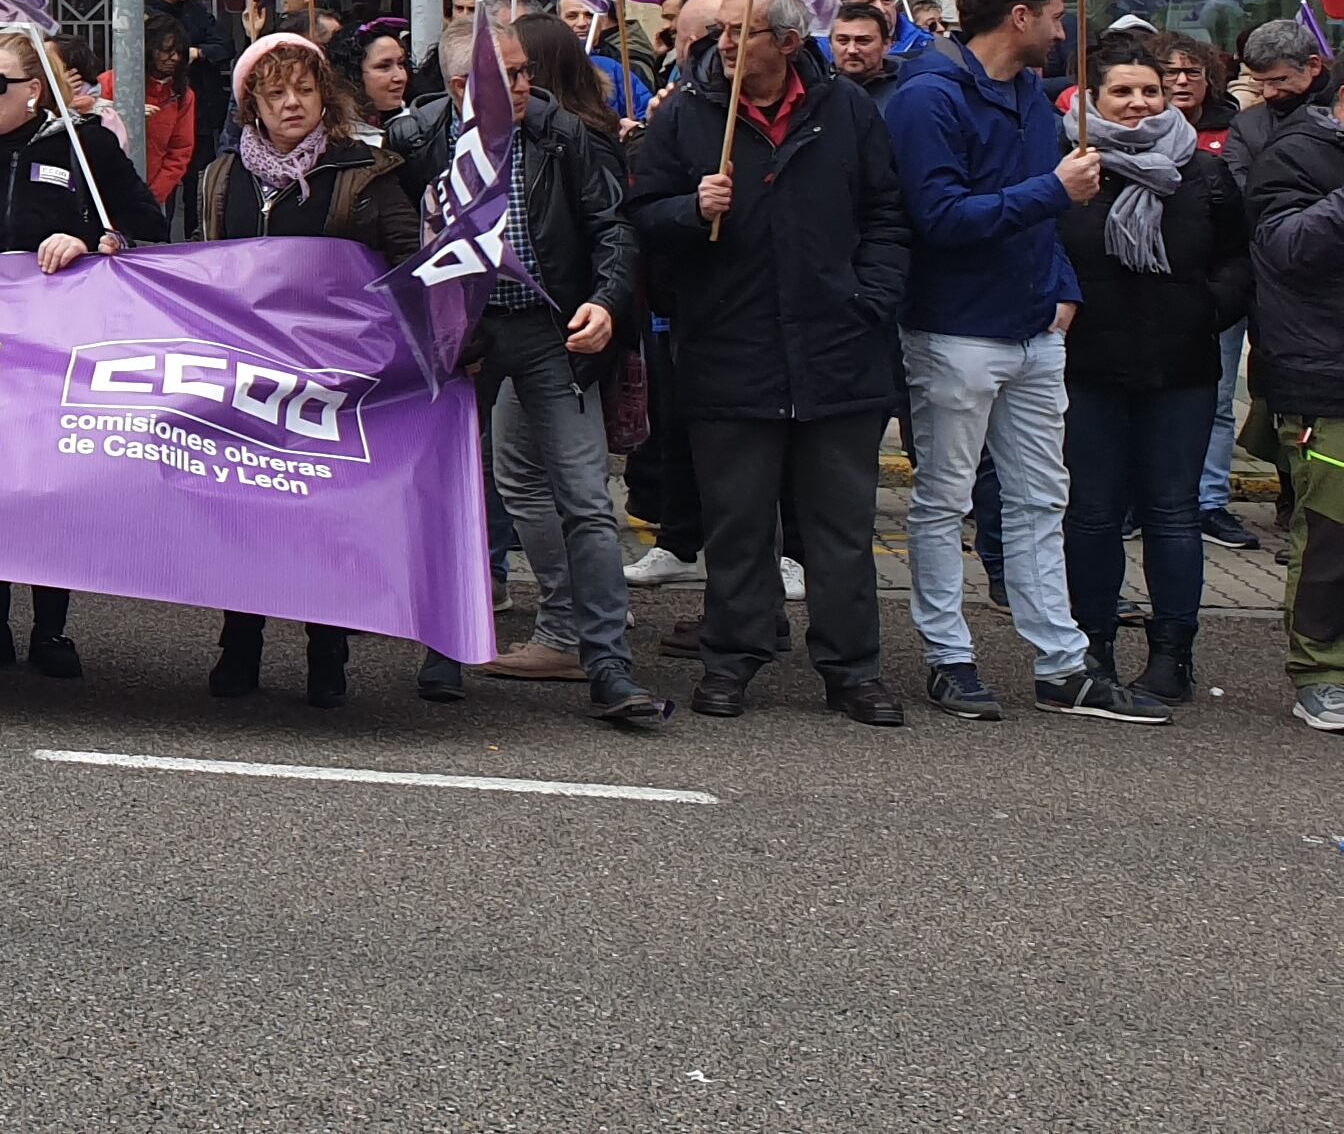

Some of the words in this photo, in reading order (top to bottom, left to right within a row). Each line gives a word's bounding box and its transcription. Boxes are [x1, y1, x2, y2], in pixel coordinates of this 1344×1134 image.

[90, 354, 349, 442] CCOO
[58, 433, 95, 455] de
[102, 434, 207, 476] Castilla
[213, 464, 229, 483] y
[237, 467, 309, 496] León
[60, 412, 217, 456] comisiones
[224, 445, 333, 479] obreras
